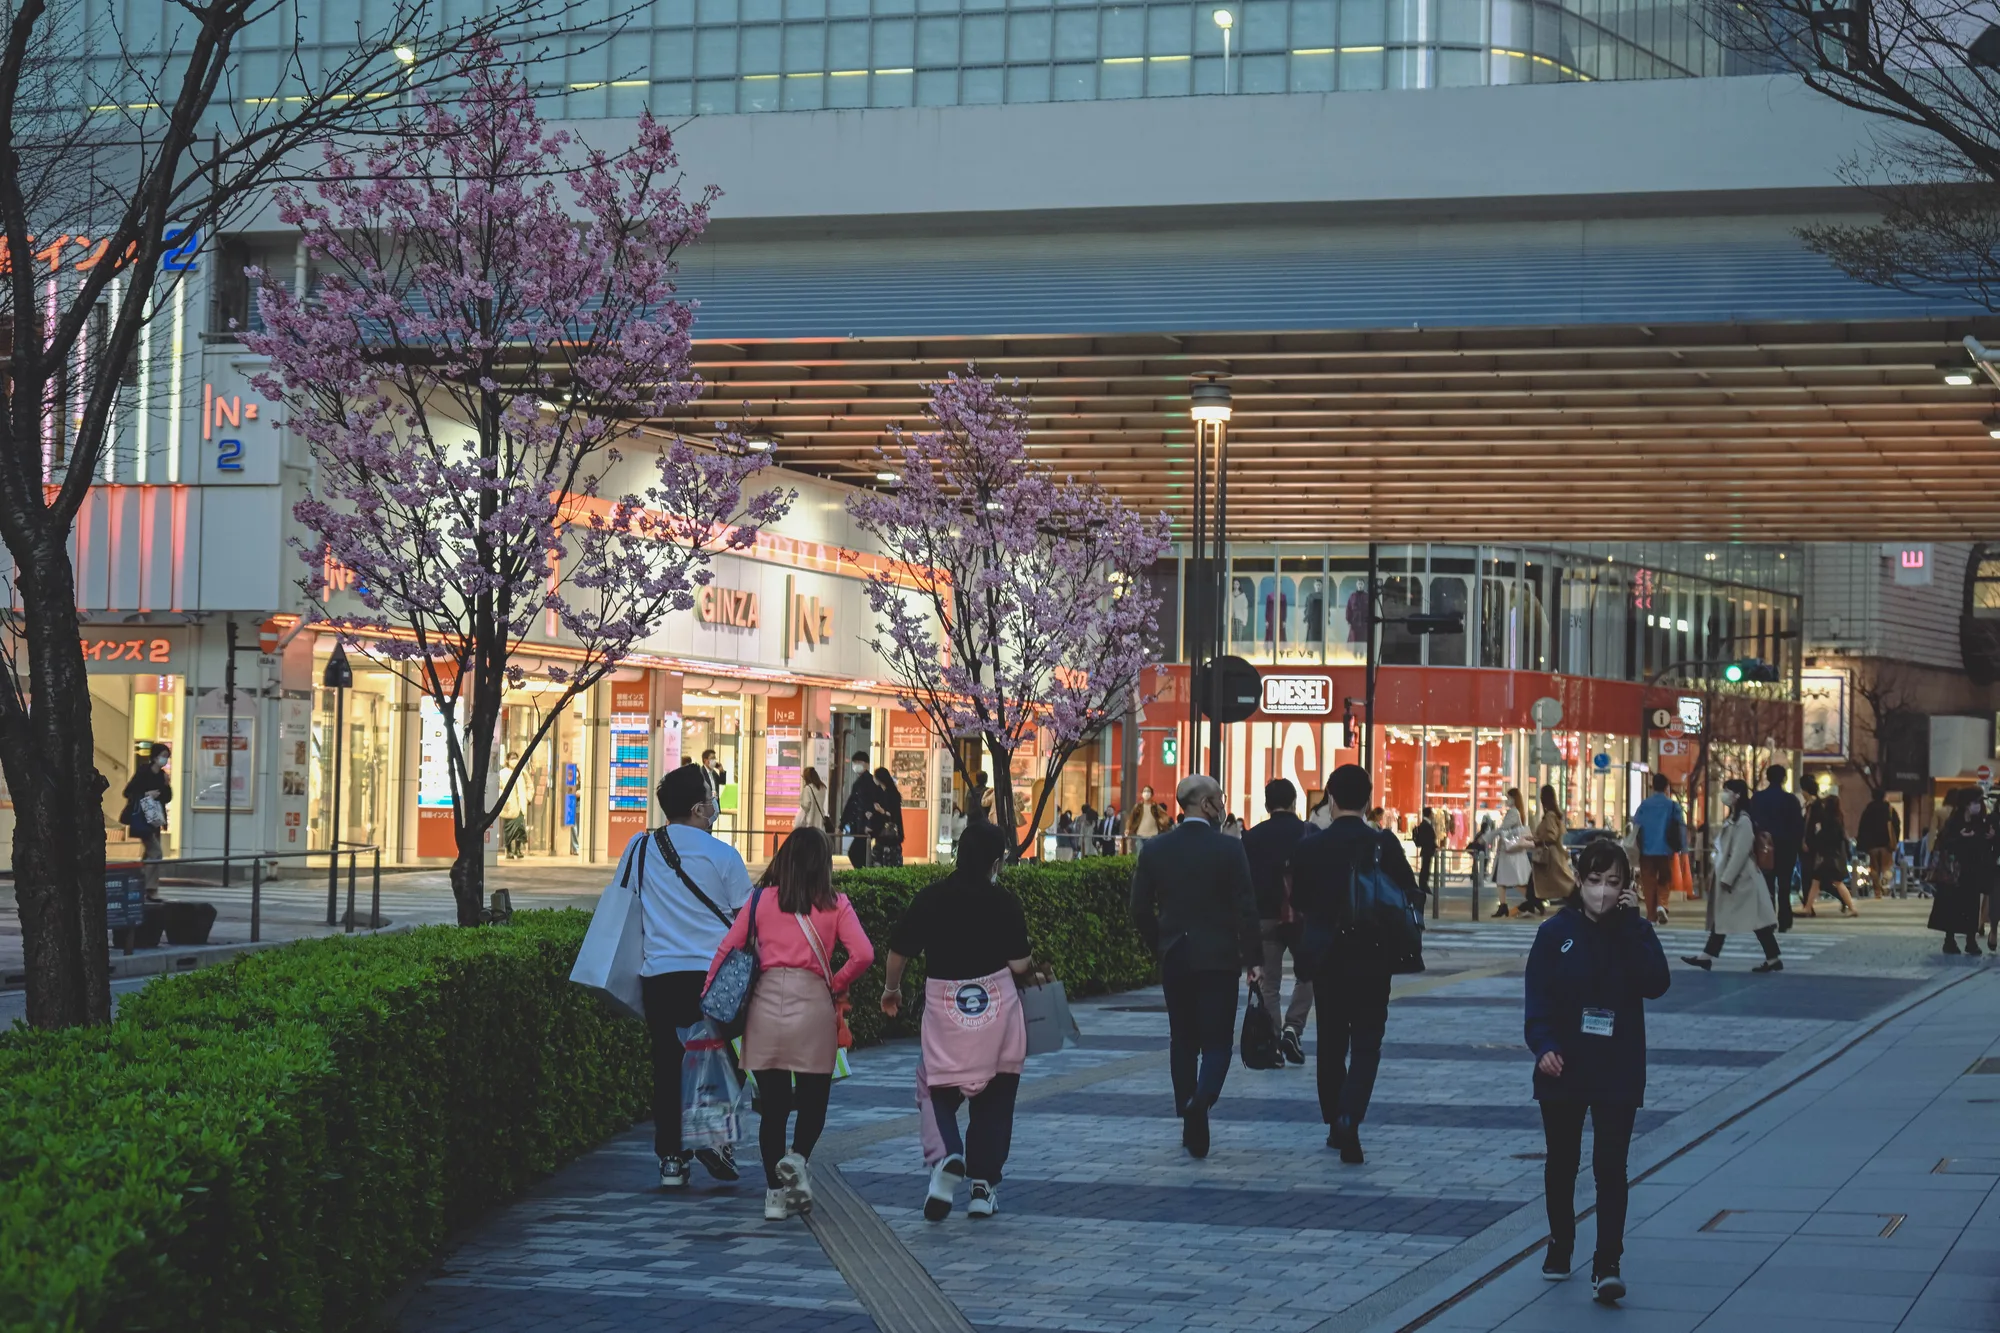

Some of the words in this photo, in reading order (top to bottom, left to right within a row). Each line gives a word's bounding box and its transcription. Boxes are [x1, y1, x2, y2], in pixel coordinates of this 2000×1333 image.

[163, 229, 197, 270] 2
[217, 439, 241, 470] 2
[700, 585, 760, 629] GINZA
[149, 639, 170, 663] 2
[1267, 680, 1326, 705] DIESEL
